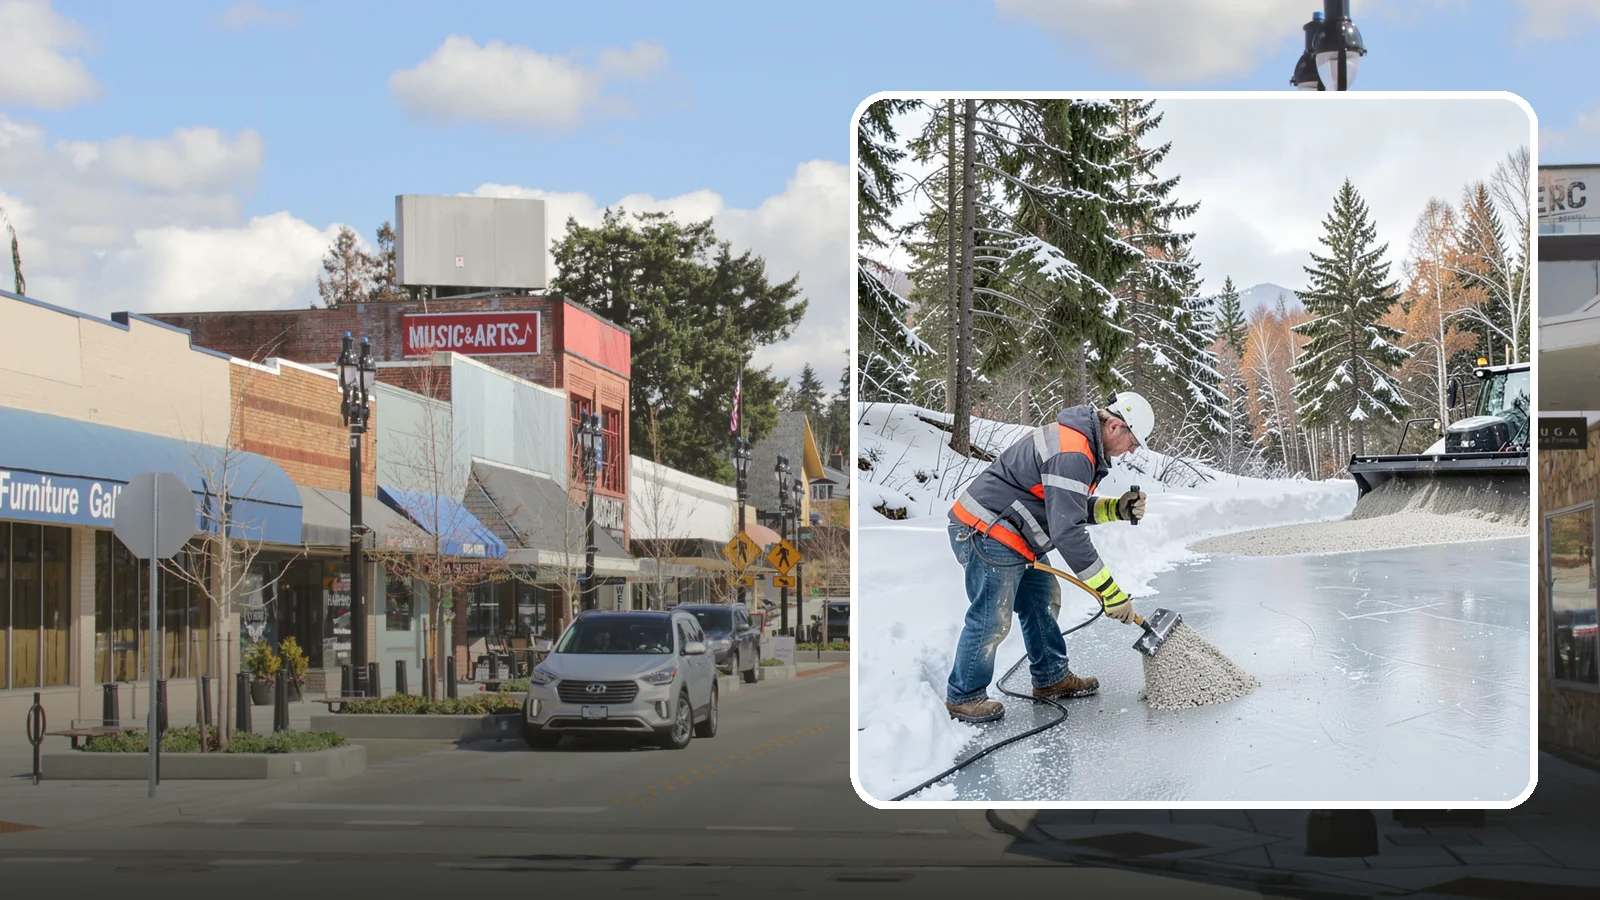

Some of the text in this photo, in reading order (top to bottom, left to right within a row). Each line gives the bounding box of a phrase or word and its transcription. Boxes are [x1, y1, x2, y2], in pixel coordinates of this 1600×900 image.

[0, 471, 122, 519] Furniture Gal
[453, 563, 480, 574] SUSHI
